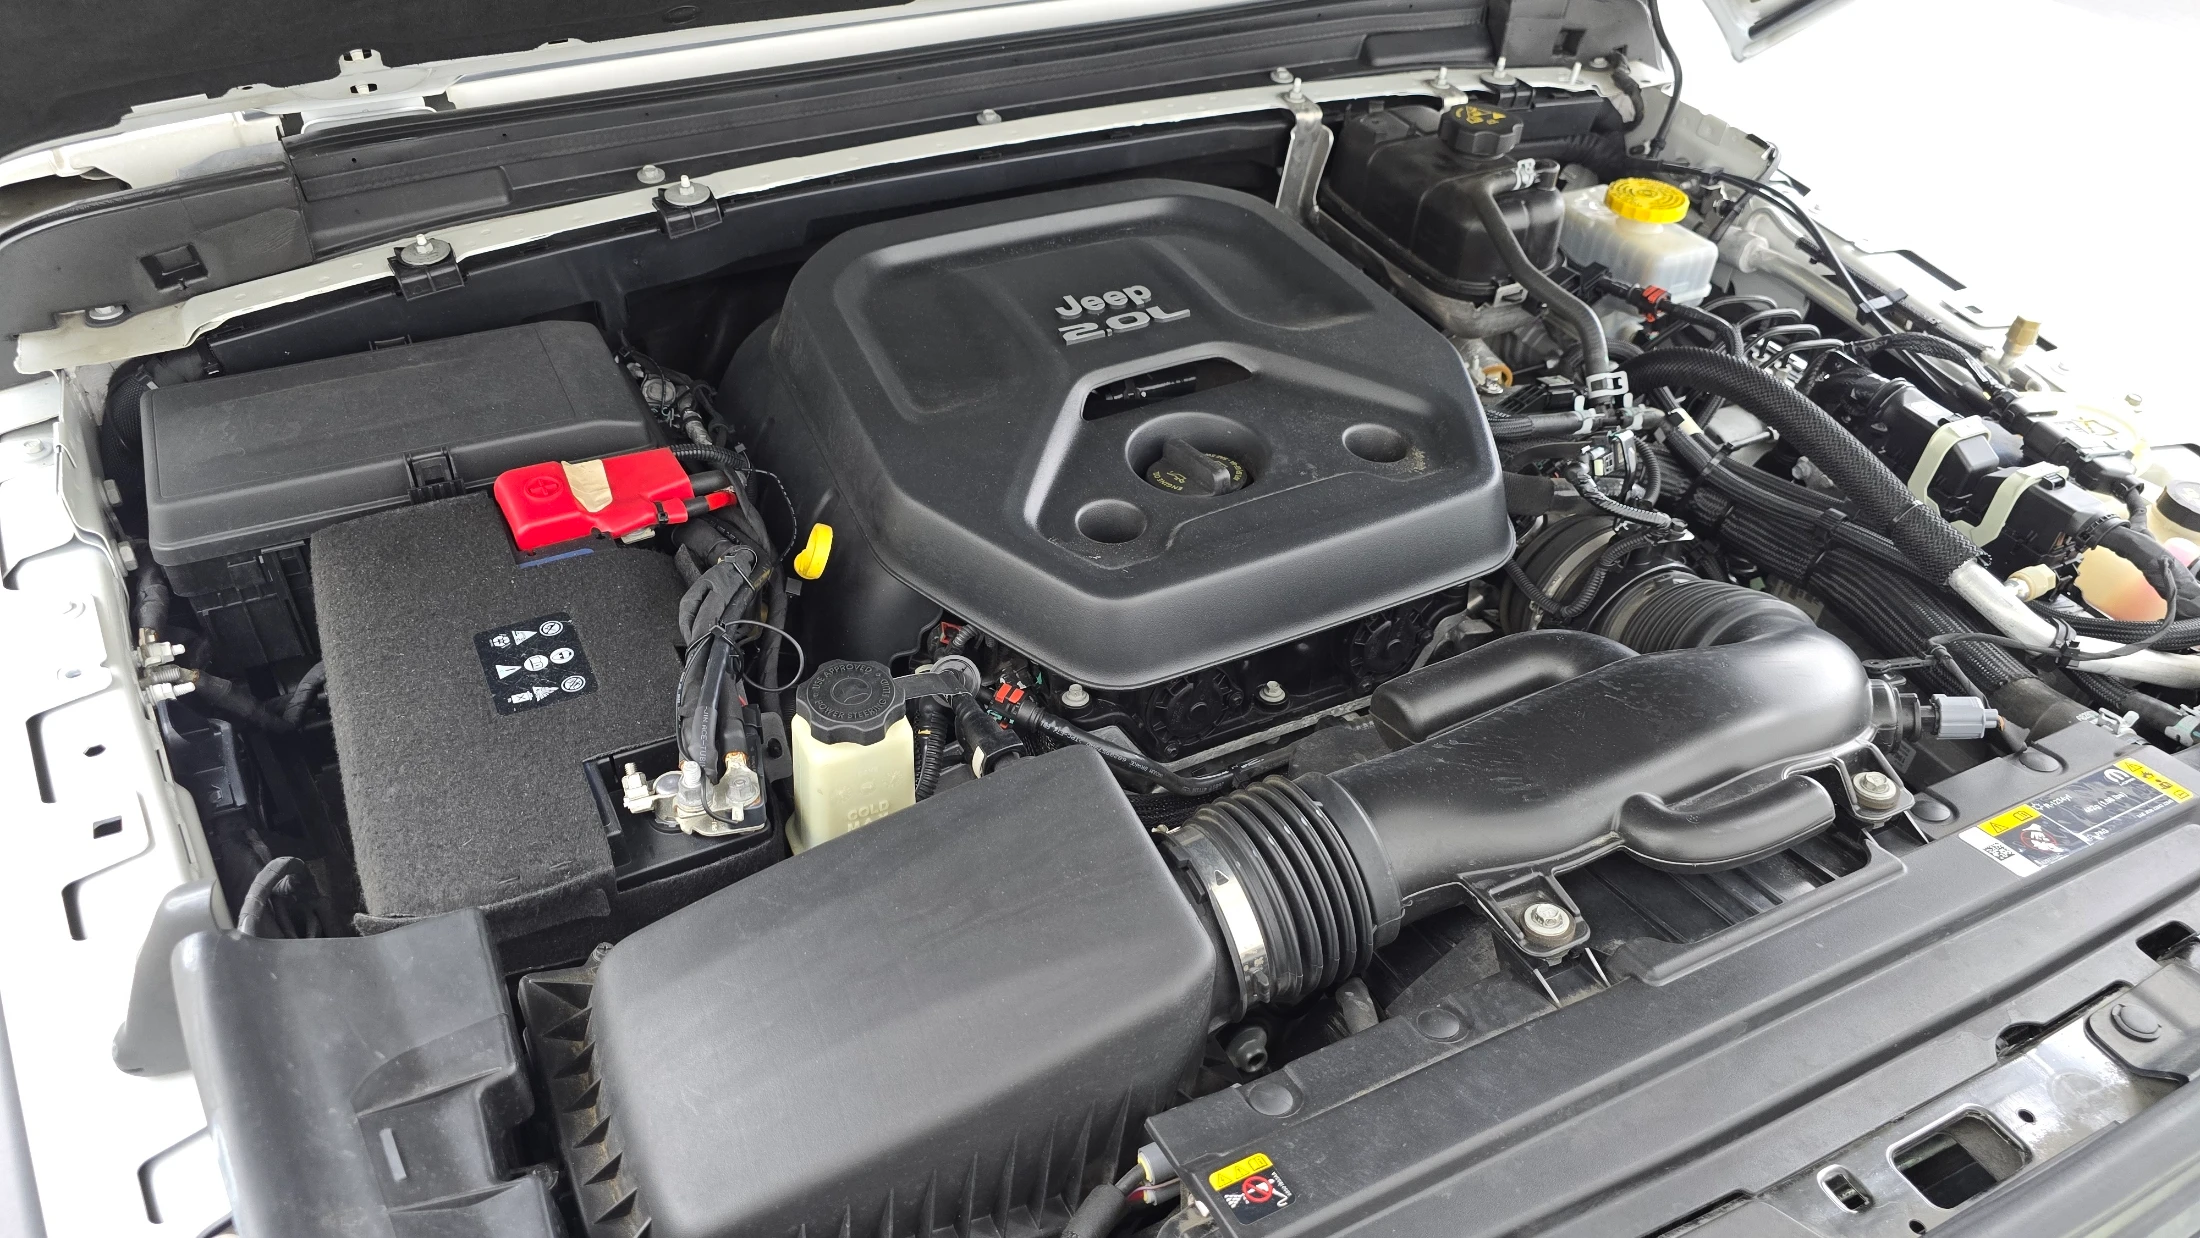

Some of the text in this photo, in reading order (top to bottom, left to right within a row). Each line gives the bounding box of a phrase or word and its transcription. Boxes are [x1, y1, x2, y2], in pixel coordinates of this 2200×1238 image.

[1055, 285, 1151, 318] Jeep
[1058, 306, 1191, 346] 2.0L
[812, 663, 872, 689] USE APPROVED
[814, 699, 844, 719] POWER
[847, 698, 887, 719] STEERING
[847, 800, 889, 821] COLD
